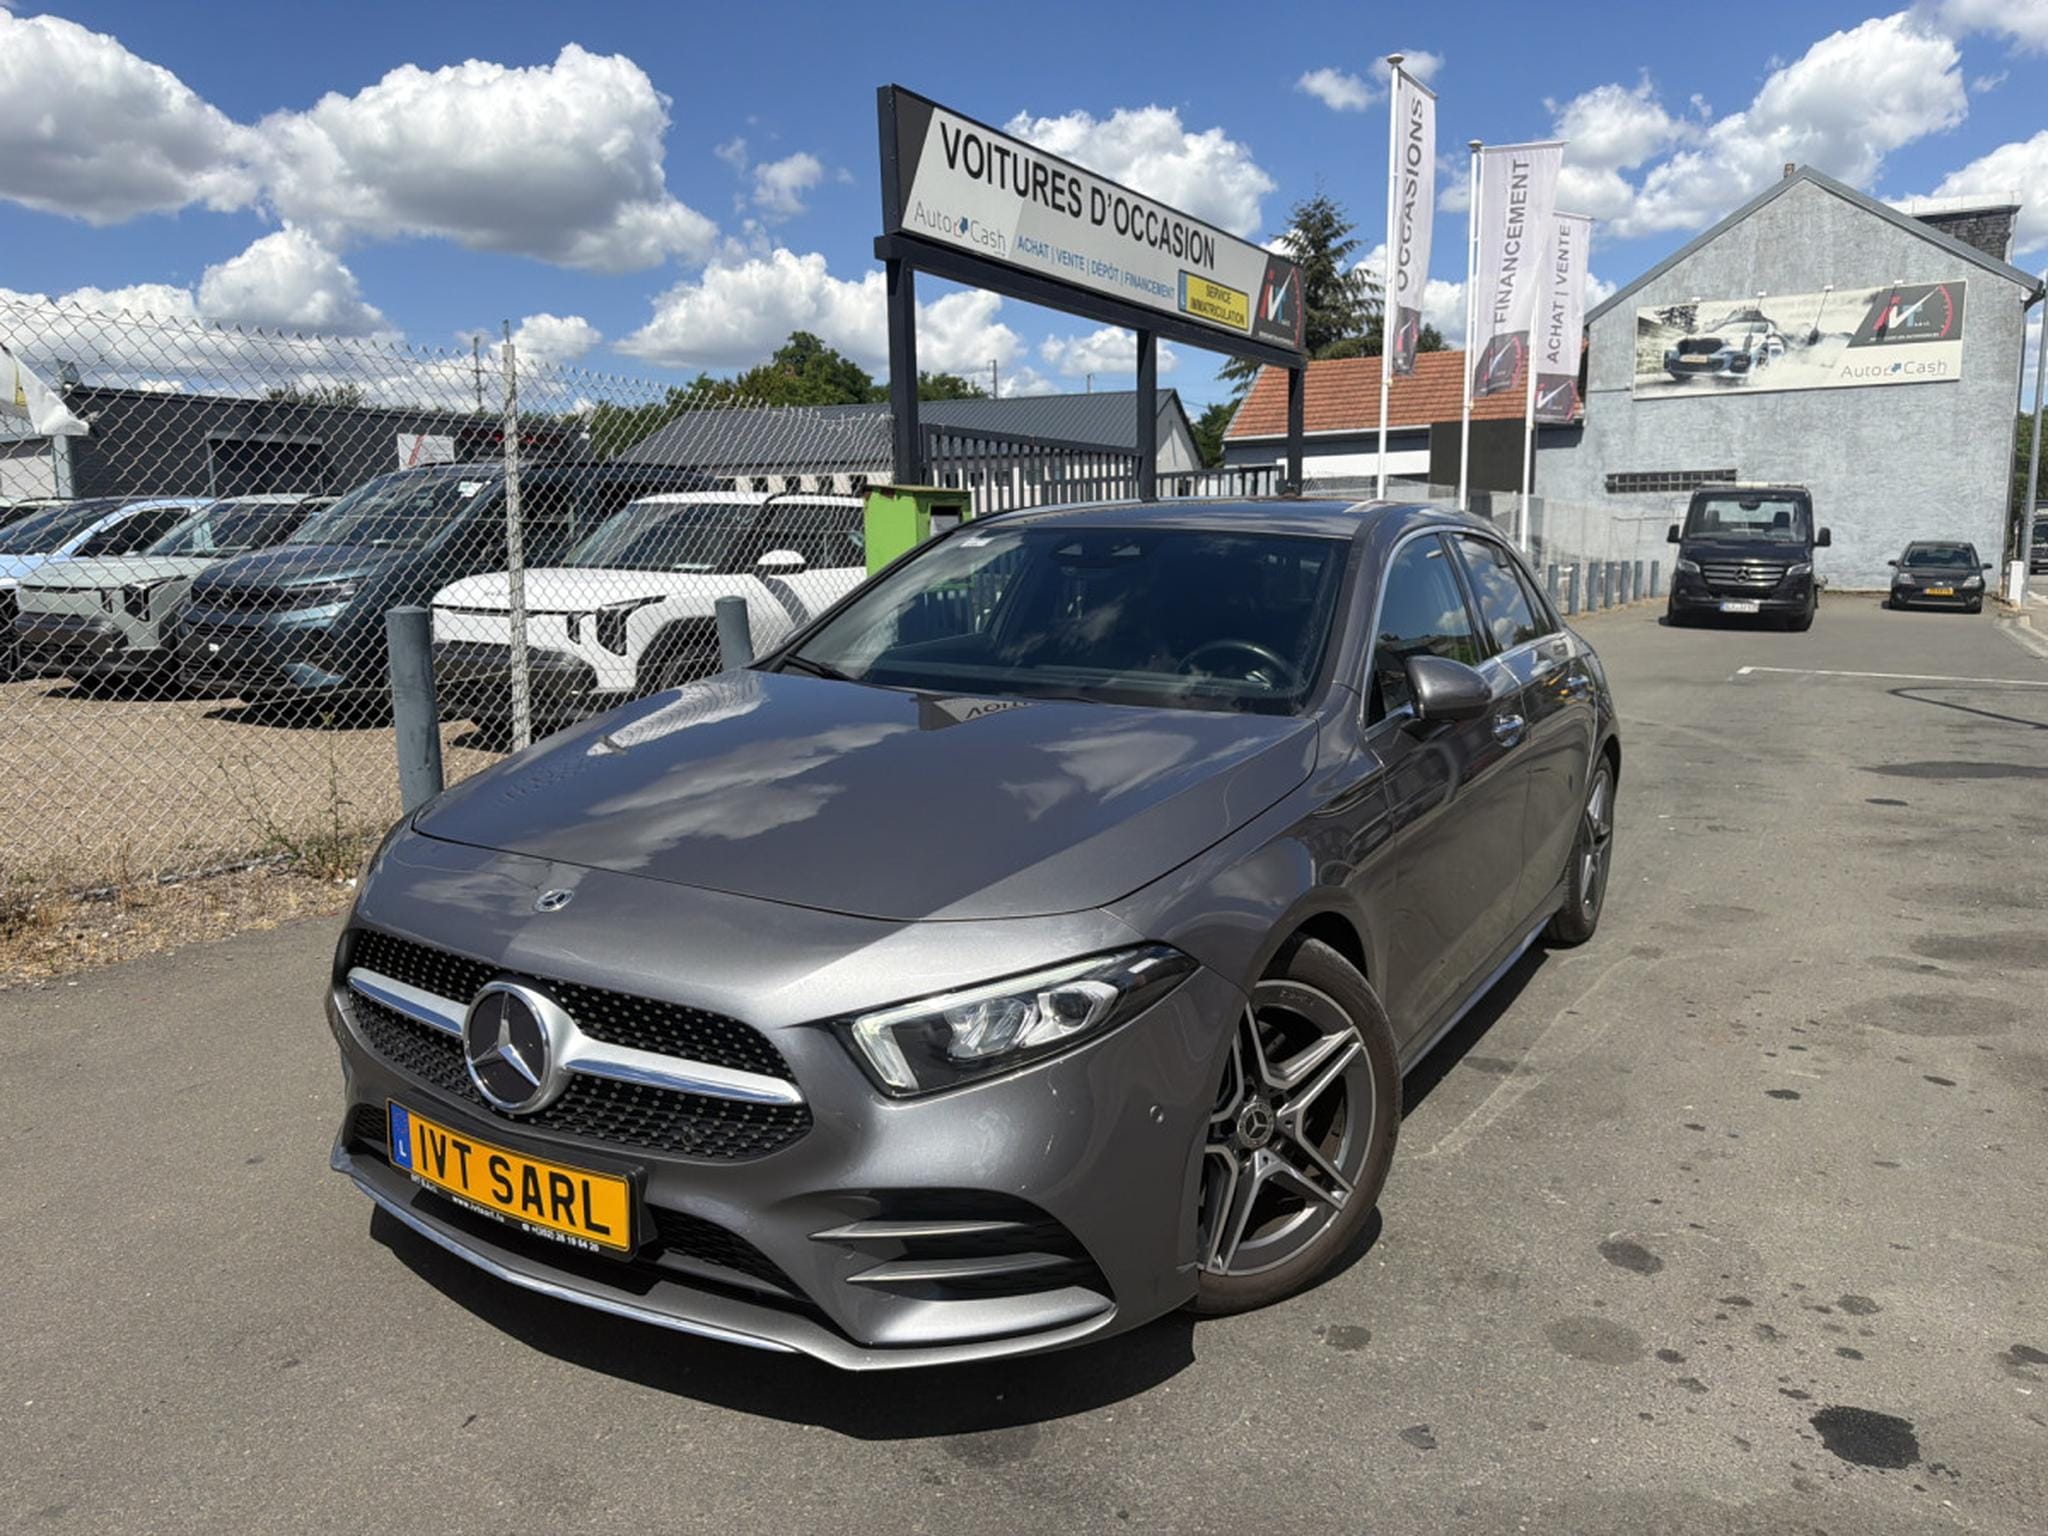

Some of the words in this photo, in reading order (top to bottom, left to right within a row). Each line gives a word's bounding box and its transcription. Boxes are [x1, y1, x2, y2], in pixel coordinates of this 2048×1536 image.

[914, 200, 952, 233] Auto
[970, 219, 1006, 252] Cash
[940, 121, 1082, 219] VOITURES
[1091, 186, 1215, 271] D'OCCASION
[1398, 96, 1423, 292] OCCASIONS
[1494, 158, 1530, 324] FINANCEMENT
[1017, 235, 1049, 258] ACHAT
[1056, 248, 1085, 271] VENTE
[1125, 272, 1175, 299] FINANCEMENT
[1545, 301, 1565, 364] ACHAT
[1555, 223, 1571, 287] VENTE
[1904, 360, 1948, 376] Cash
[399, 1139, 407, 1158] L
[419, 1124, 472, 1190] IVT
[489, 1155, 611, 1236] SARL
